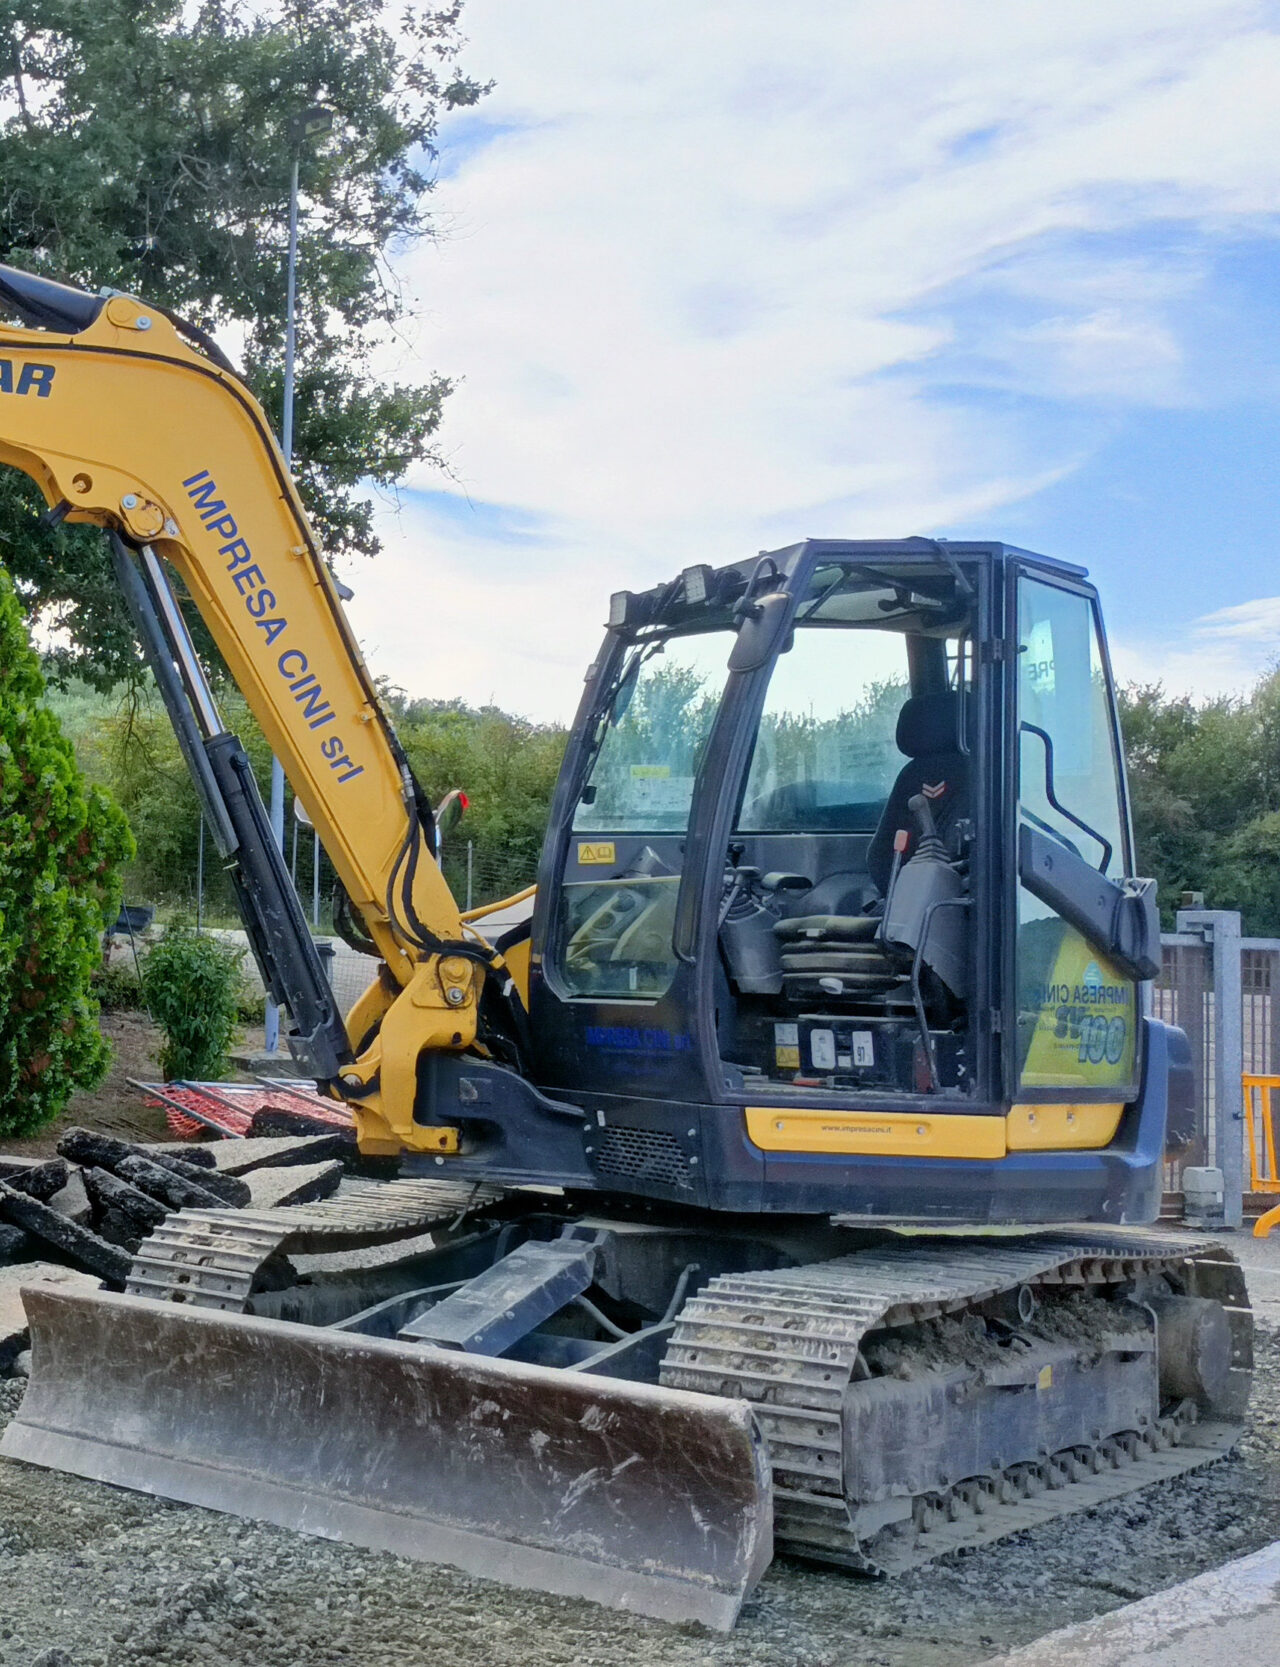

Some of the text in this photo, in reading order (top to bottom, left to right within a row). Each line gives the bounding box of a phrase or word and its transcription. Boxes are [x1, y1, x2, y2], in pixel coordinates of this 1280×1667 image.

[182, 469, 365, 783] IMPRESA CINI srl
